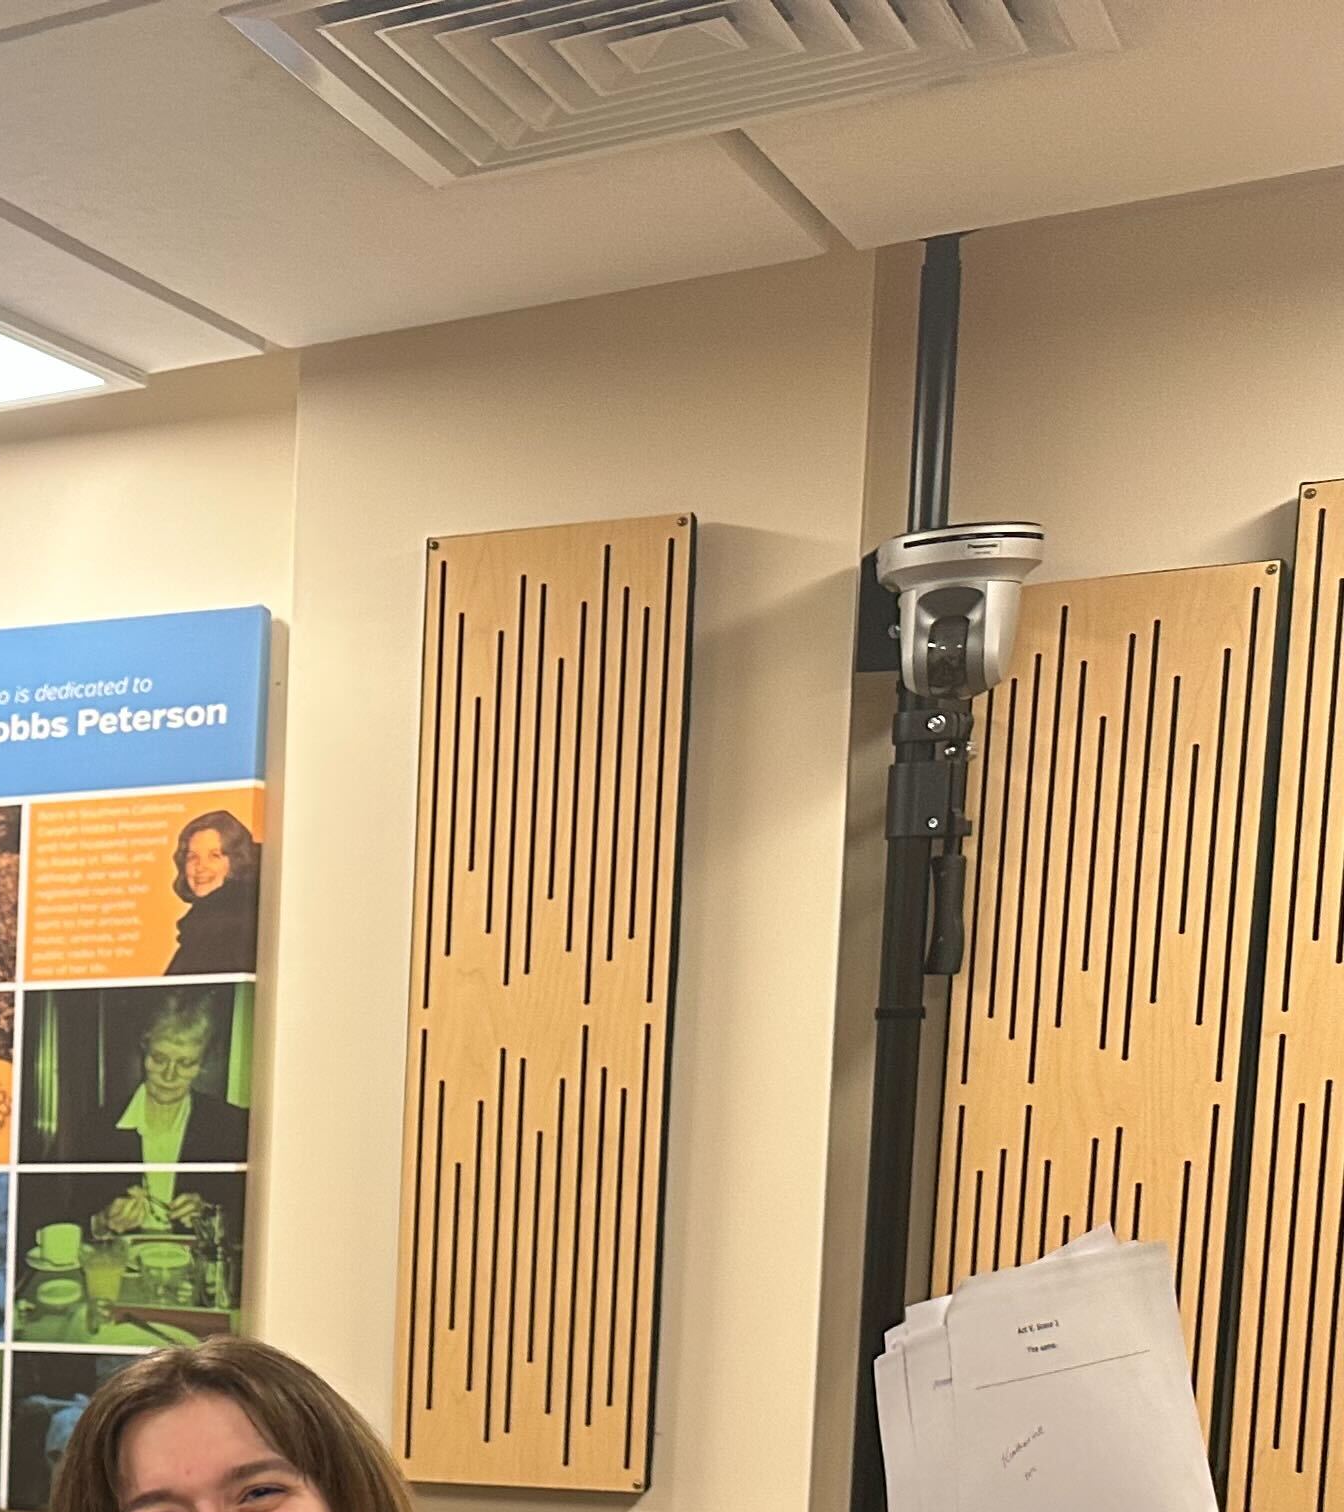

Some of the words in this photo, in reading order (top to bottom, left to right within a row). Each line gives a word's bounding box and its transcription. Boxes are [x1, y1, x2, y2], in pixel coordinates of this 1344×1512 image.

[13, 686, 29, 705] is
[34, 676, 128, 704] dedicated
[131, 677, 153, 695] to
[77, 703, 228, 736] Peterson
